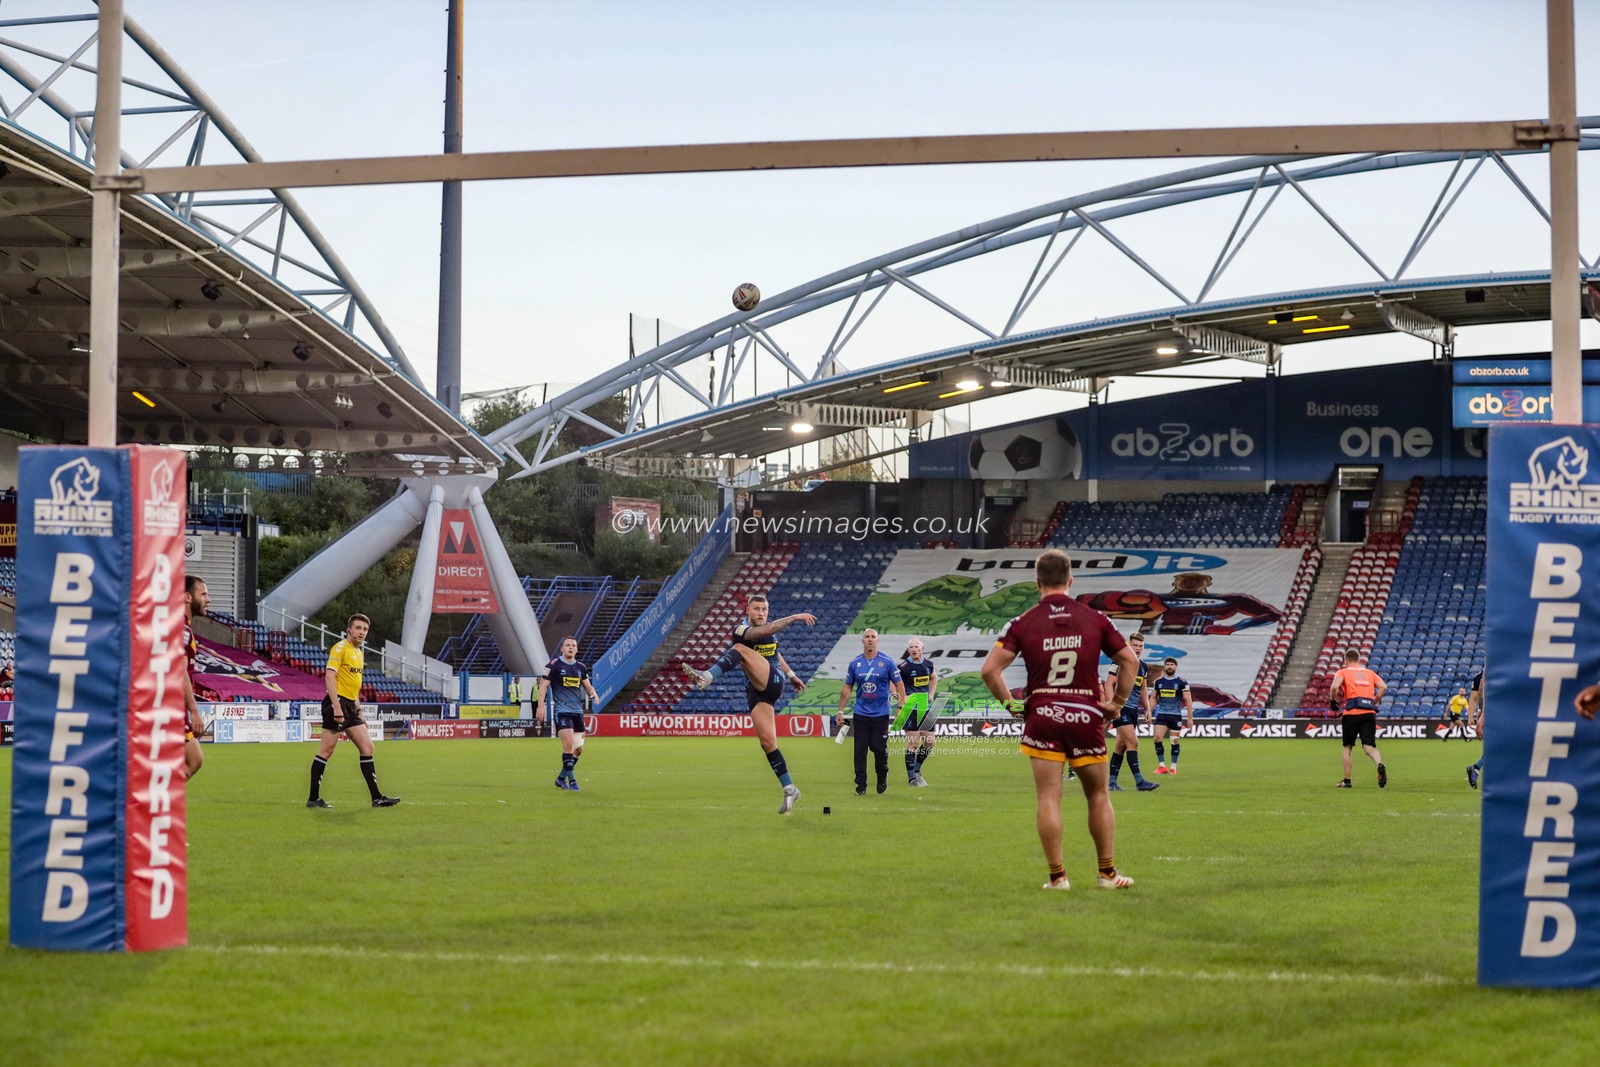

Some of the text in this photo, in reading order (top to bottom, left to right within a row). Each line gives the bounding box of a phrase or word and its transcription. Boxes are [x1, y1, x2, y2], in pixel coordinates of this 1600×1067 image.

[1469, 366, 1530, 376] abzorb.co.uk
[1307, 401, 1379, 417] Business
[1340, 426, 1434, 458] one
[1510, 490, 1600, 507] RHINO
[34, 507, 113, 520] RHINO
[1510, 513, 1551, 523] RUGBY
[34, 526, 113, 536] RUGBY LEAGUE
[956, 555, 1129, 572] bod
[438, 566, 484, 577] DIRECT
[636, 601, 666, 645] CONTROL
[665, 573, 691, 607] Freedom
[1043, 635, 1082, 651] CLOUGH
[1047, 650, 1078, 687] 8
[230, 707, 245, 716] SYKES
[620, 715, 754, 729] HEPWORTH HOND
[217, 723, 233, 740] HEC
[286, 721, 301, 740] HEC
[417, 724, 454, 737] HINCHLIFFE'S
[935, 723, 973, 736] JASIC
[993, 723, 1026, 736] JASI
[1187, 724, 1231, 737] JASIC
[1252, 724, 1296, 737] JASIC
[1317, 724, 1343, 737] JAS
[1384, 724, 1427, 737] JASIC
[42, 552, 96, 923] BETFRED
[149, 553, 174, 920] BETFRED
[1520, 542, 1583, 958] BETFRED
